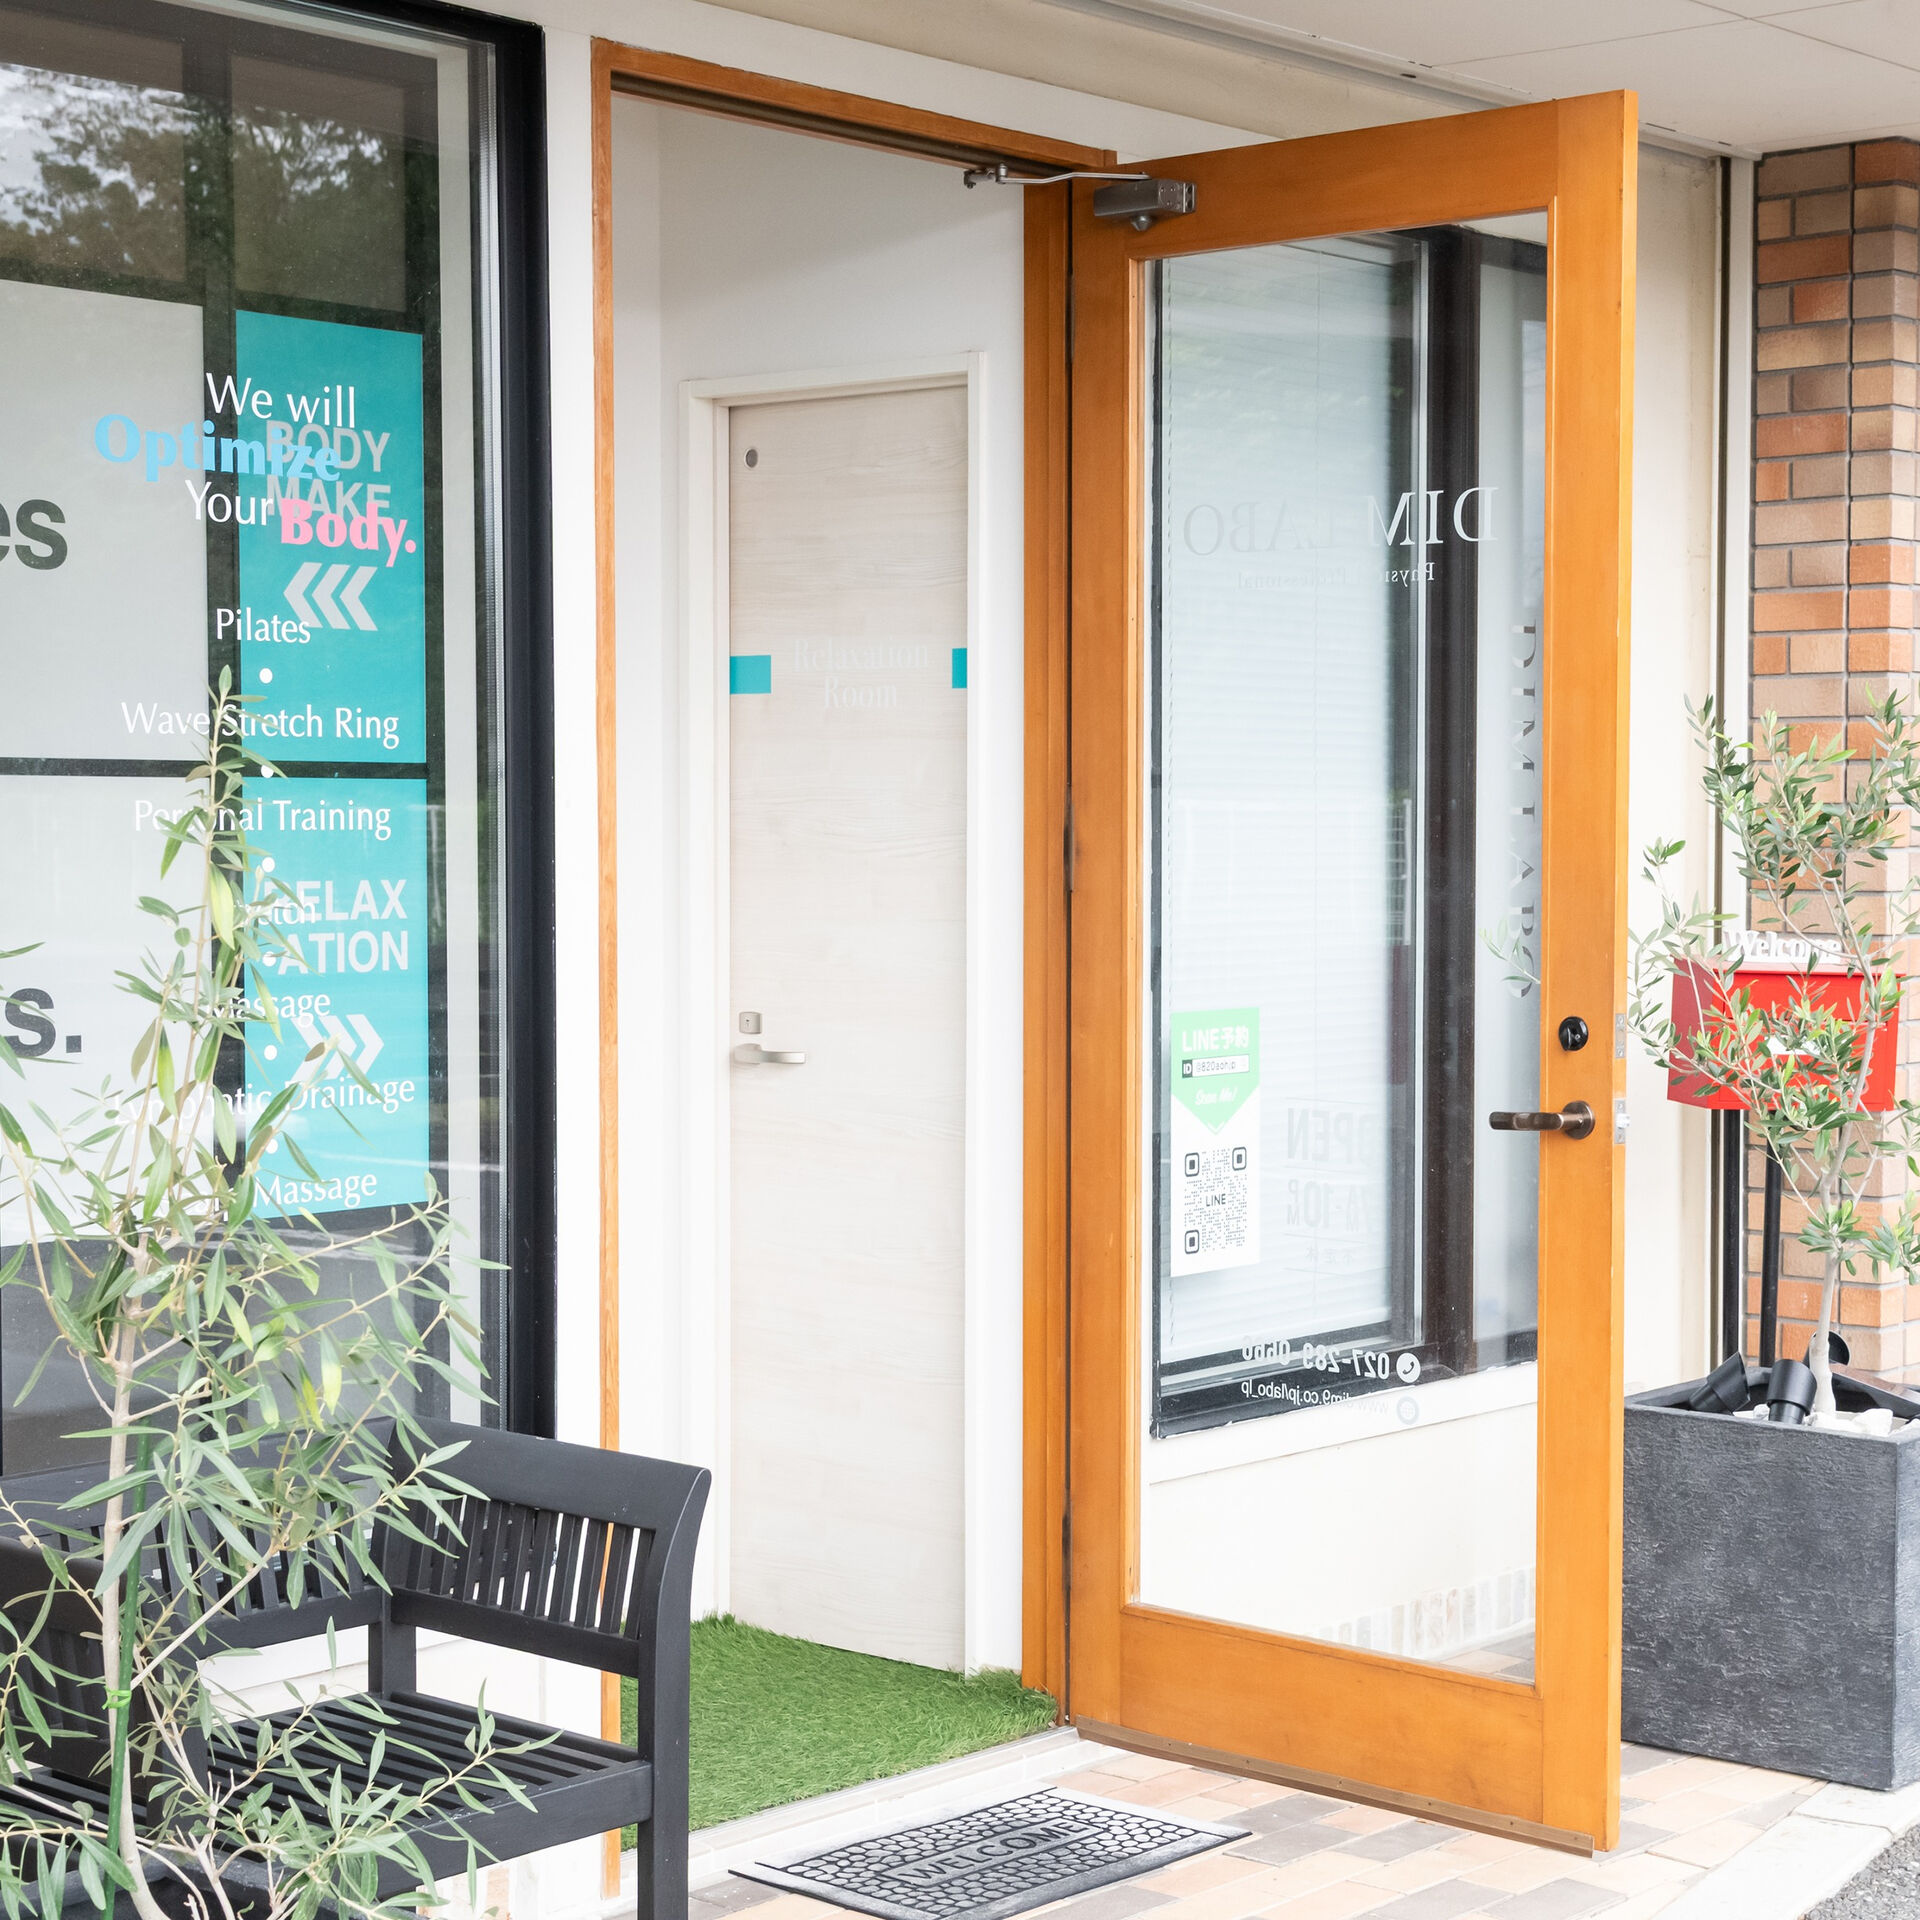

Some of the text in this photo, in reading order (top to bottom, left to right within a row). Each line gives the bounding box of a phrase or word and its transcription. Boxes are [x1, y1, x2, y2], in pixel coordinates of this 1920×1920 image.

[206, 372, 355, 428] We will
[95, 413, 341, 482] Optimize
[266, 420, 391, 472] BODY
[185, 480, 417, 568] Your Body.
[216, 608, 311, 644] Pilates
[792, 636, 929, 673] Relaxation
[824, 675, 898, 709] Room
[121, 702, 400, 750] Wave Stretch Ring
[272, 799, 392, 841] Training
[1183, 1063, 1192, 1075] ID
[253, 1172, 378, 1208] Massage
[1205, 1192, 1227, 1206] LINE
[901, 1820, 1089, 1882] WELCOME
